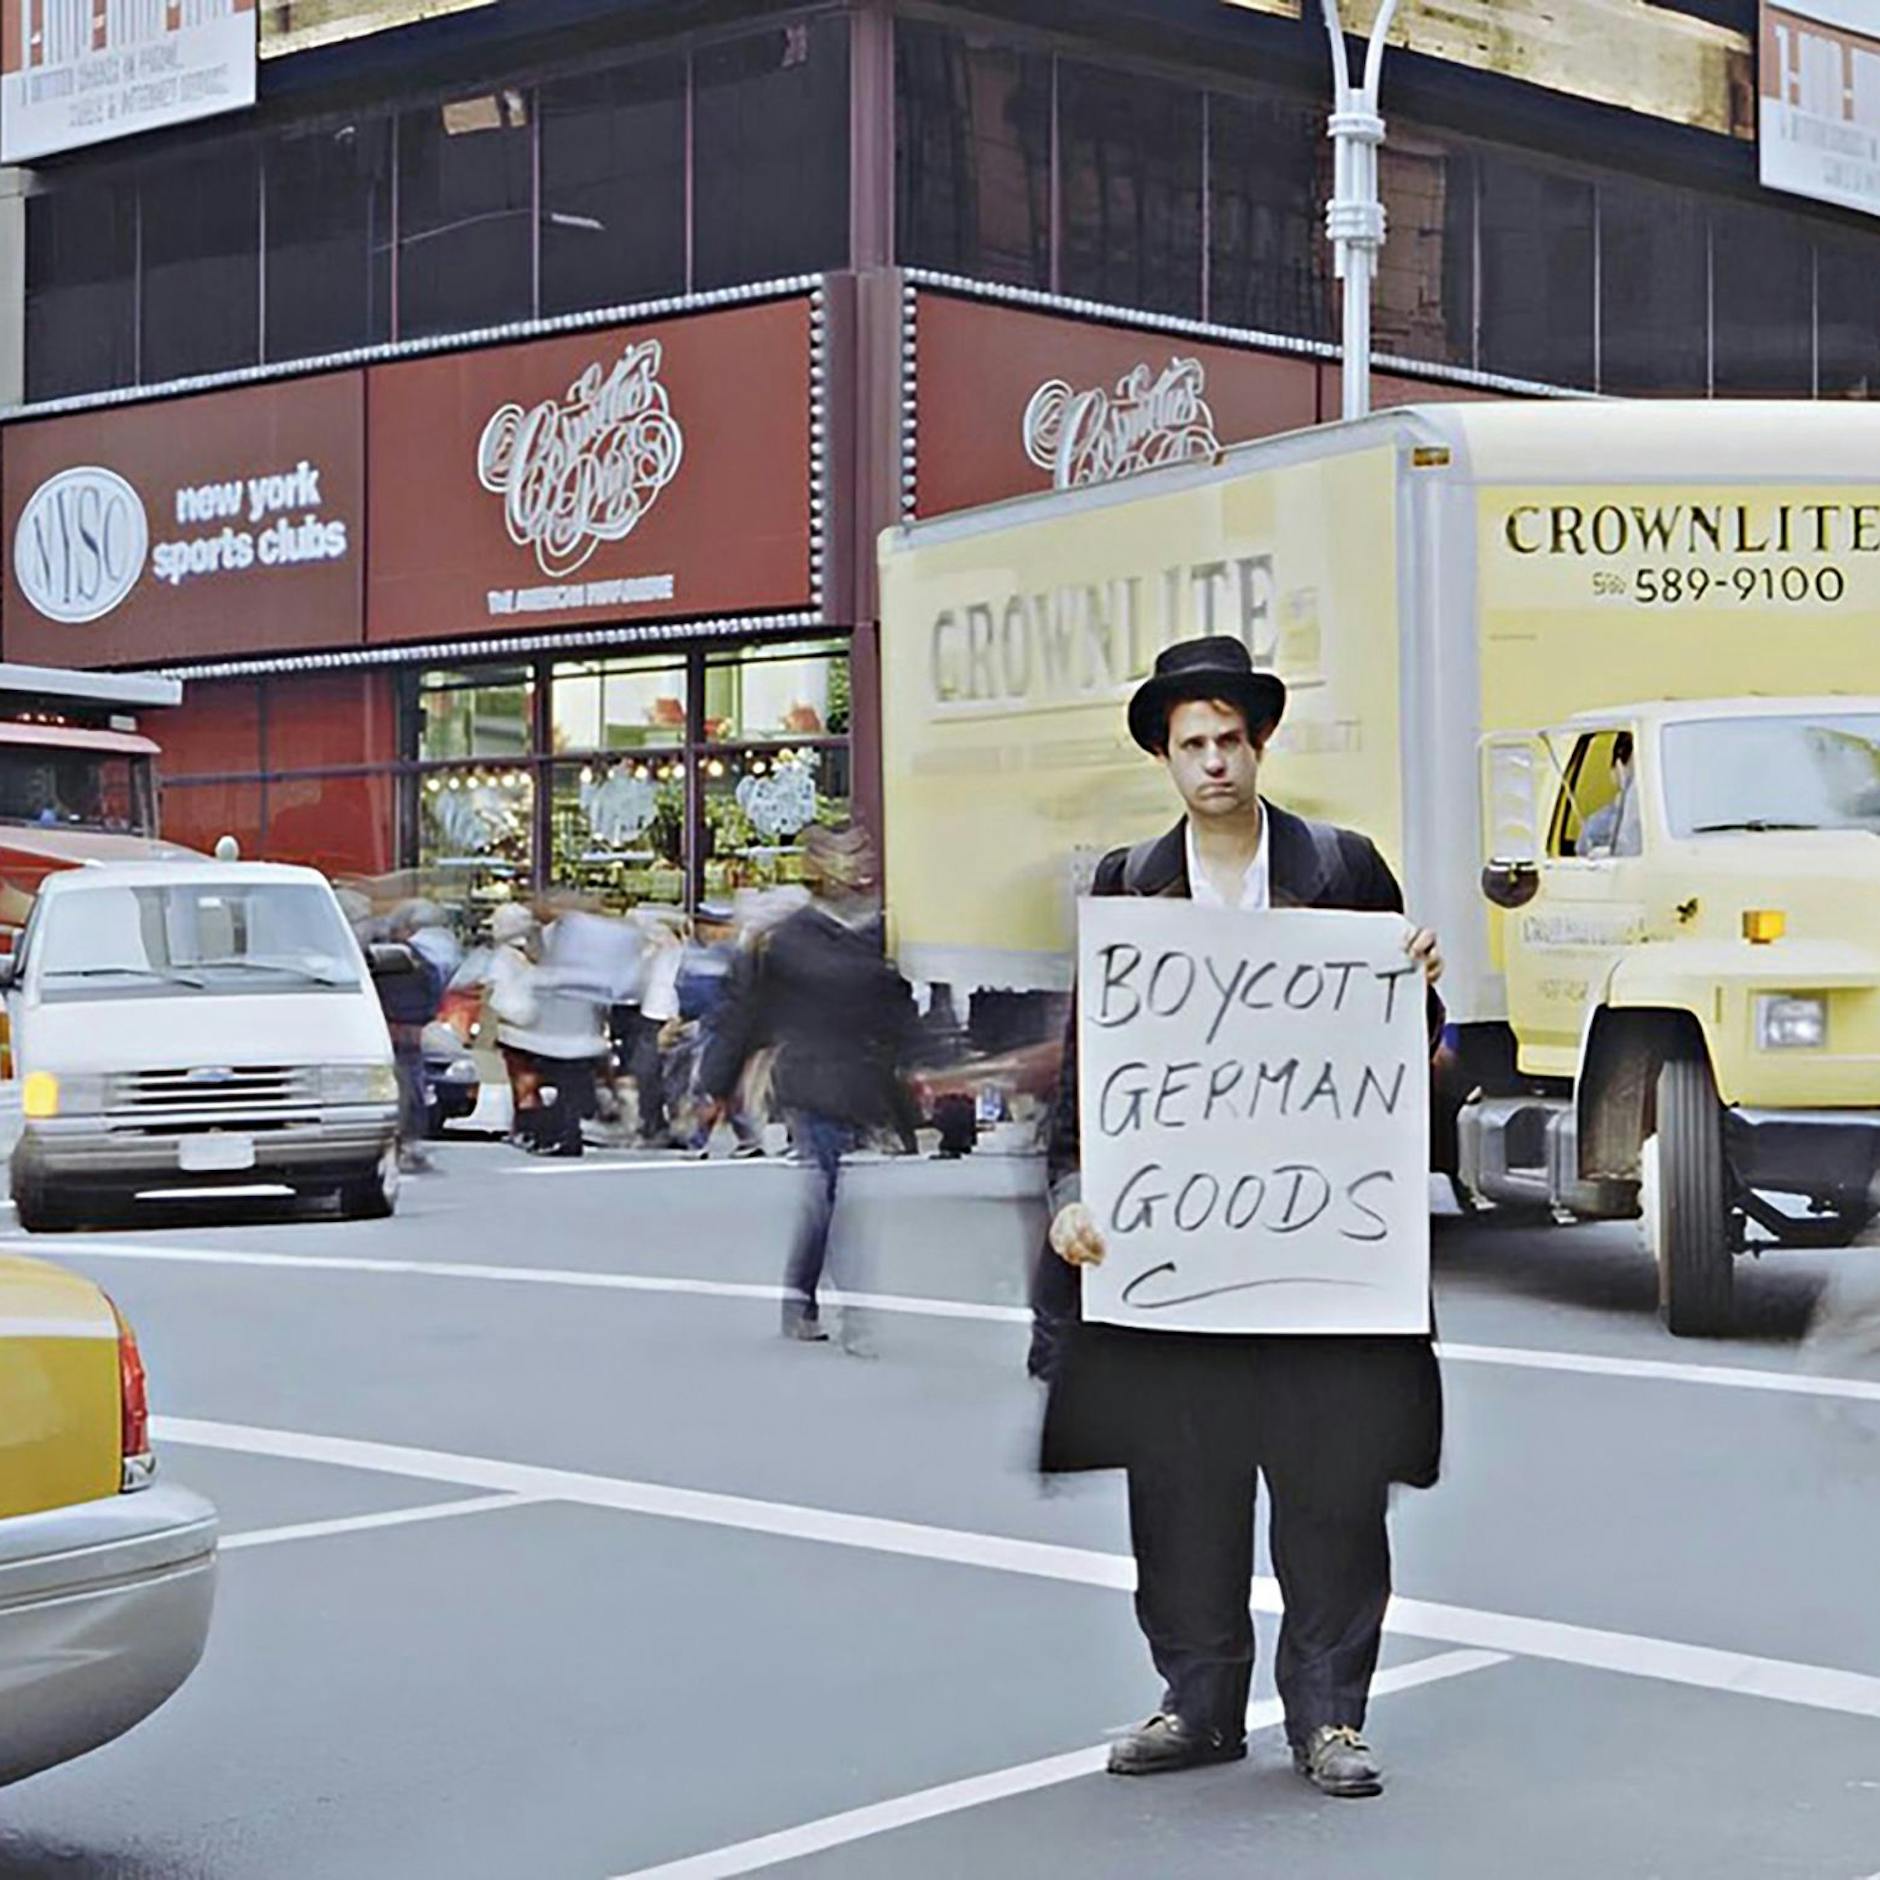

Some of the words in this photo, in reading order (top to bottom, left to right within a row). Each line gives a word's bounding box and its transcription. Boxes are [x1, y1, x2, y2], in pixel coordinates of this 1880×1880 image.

[175, 480, 243, 524] new
[248, 461, 322, 522] york
[152, 527, 254, 585] sports
[257, 514, 348, 565] clubs
[1505, 505, 1880, 555] CROWNLITE
[1634, 566, 1844, 603] 589-9100
[1088, 943, 1420, 1044] BOYCOTT
[1099, 1057, 1406, 1137] GERMAN
[1111, 1163, 1394, 1242] GOODS
